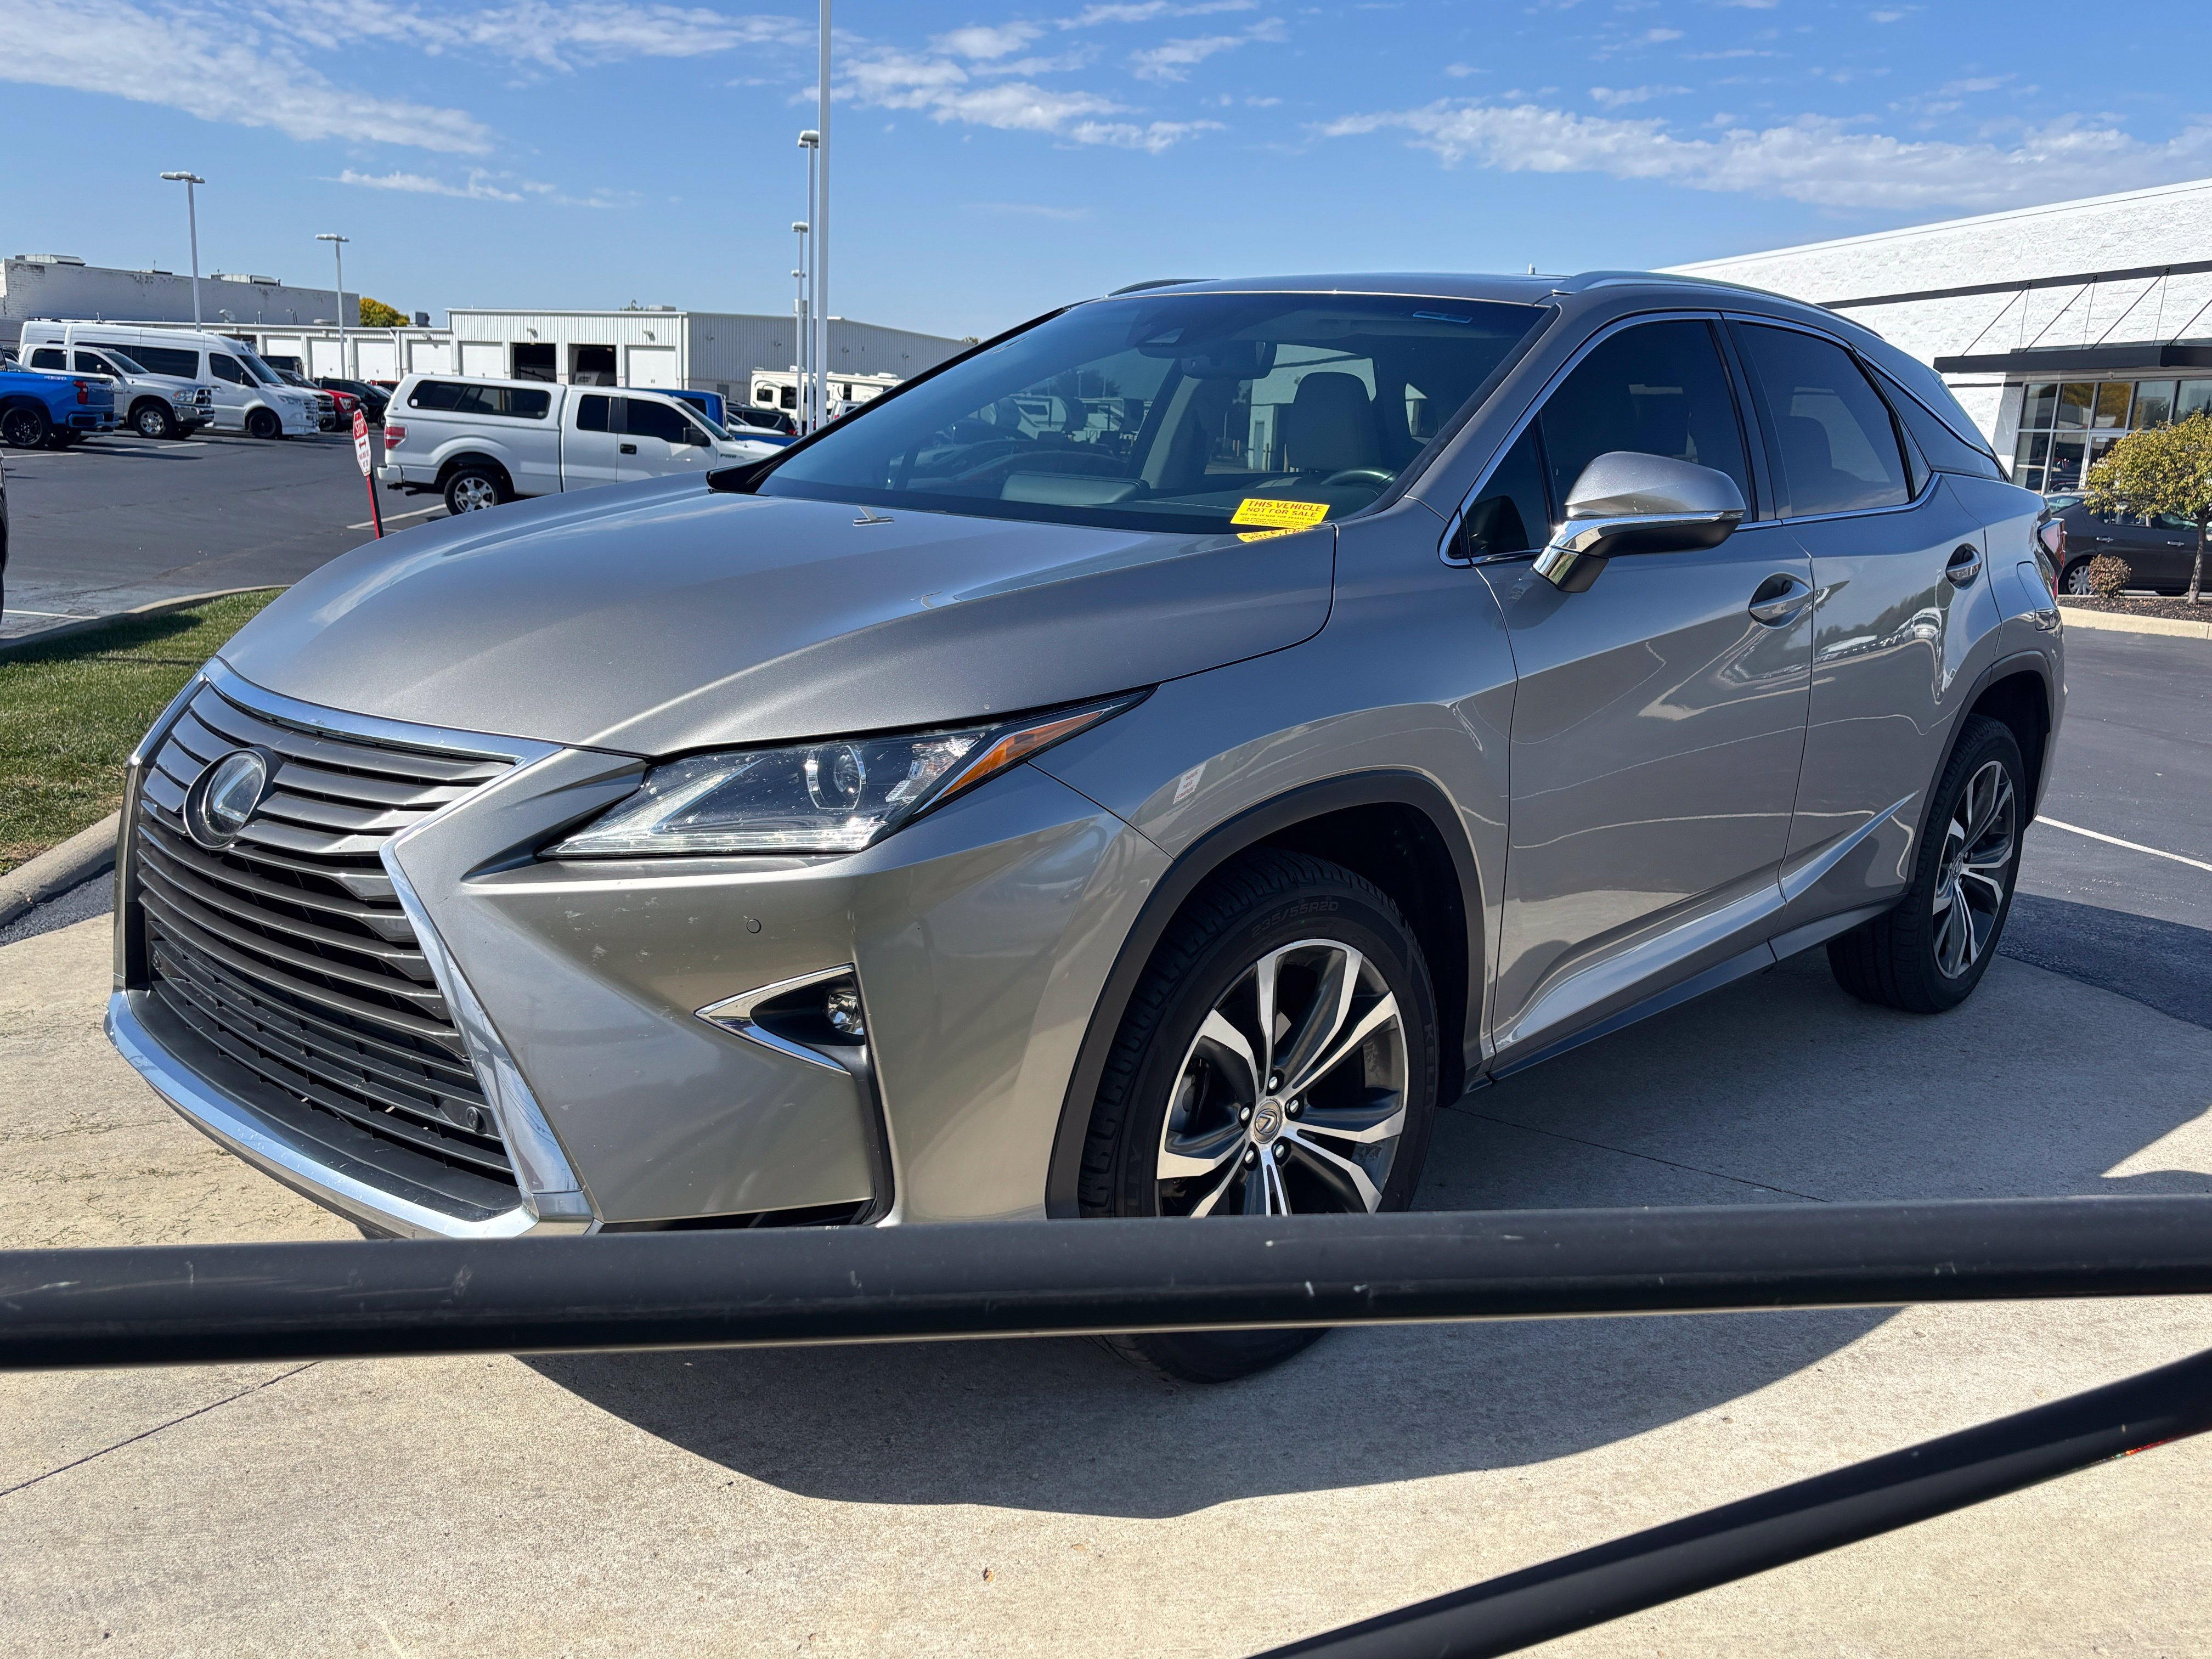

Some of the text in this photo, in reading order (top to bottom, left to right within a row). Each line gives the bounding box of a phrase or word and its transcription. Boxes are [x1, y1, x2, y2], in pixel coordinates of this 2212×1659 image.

[355, 417, 364, 437] STOP
[1277, 503, 1324, 512] VEHICLE
[1251, 901, 1339, 939] 235/55R20
